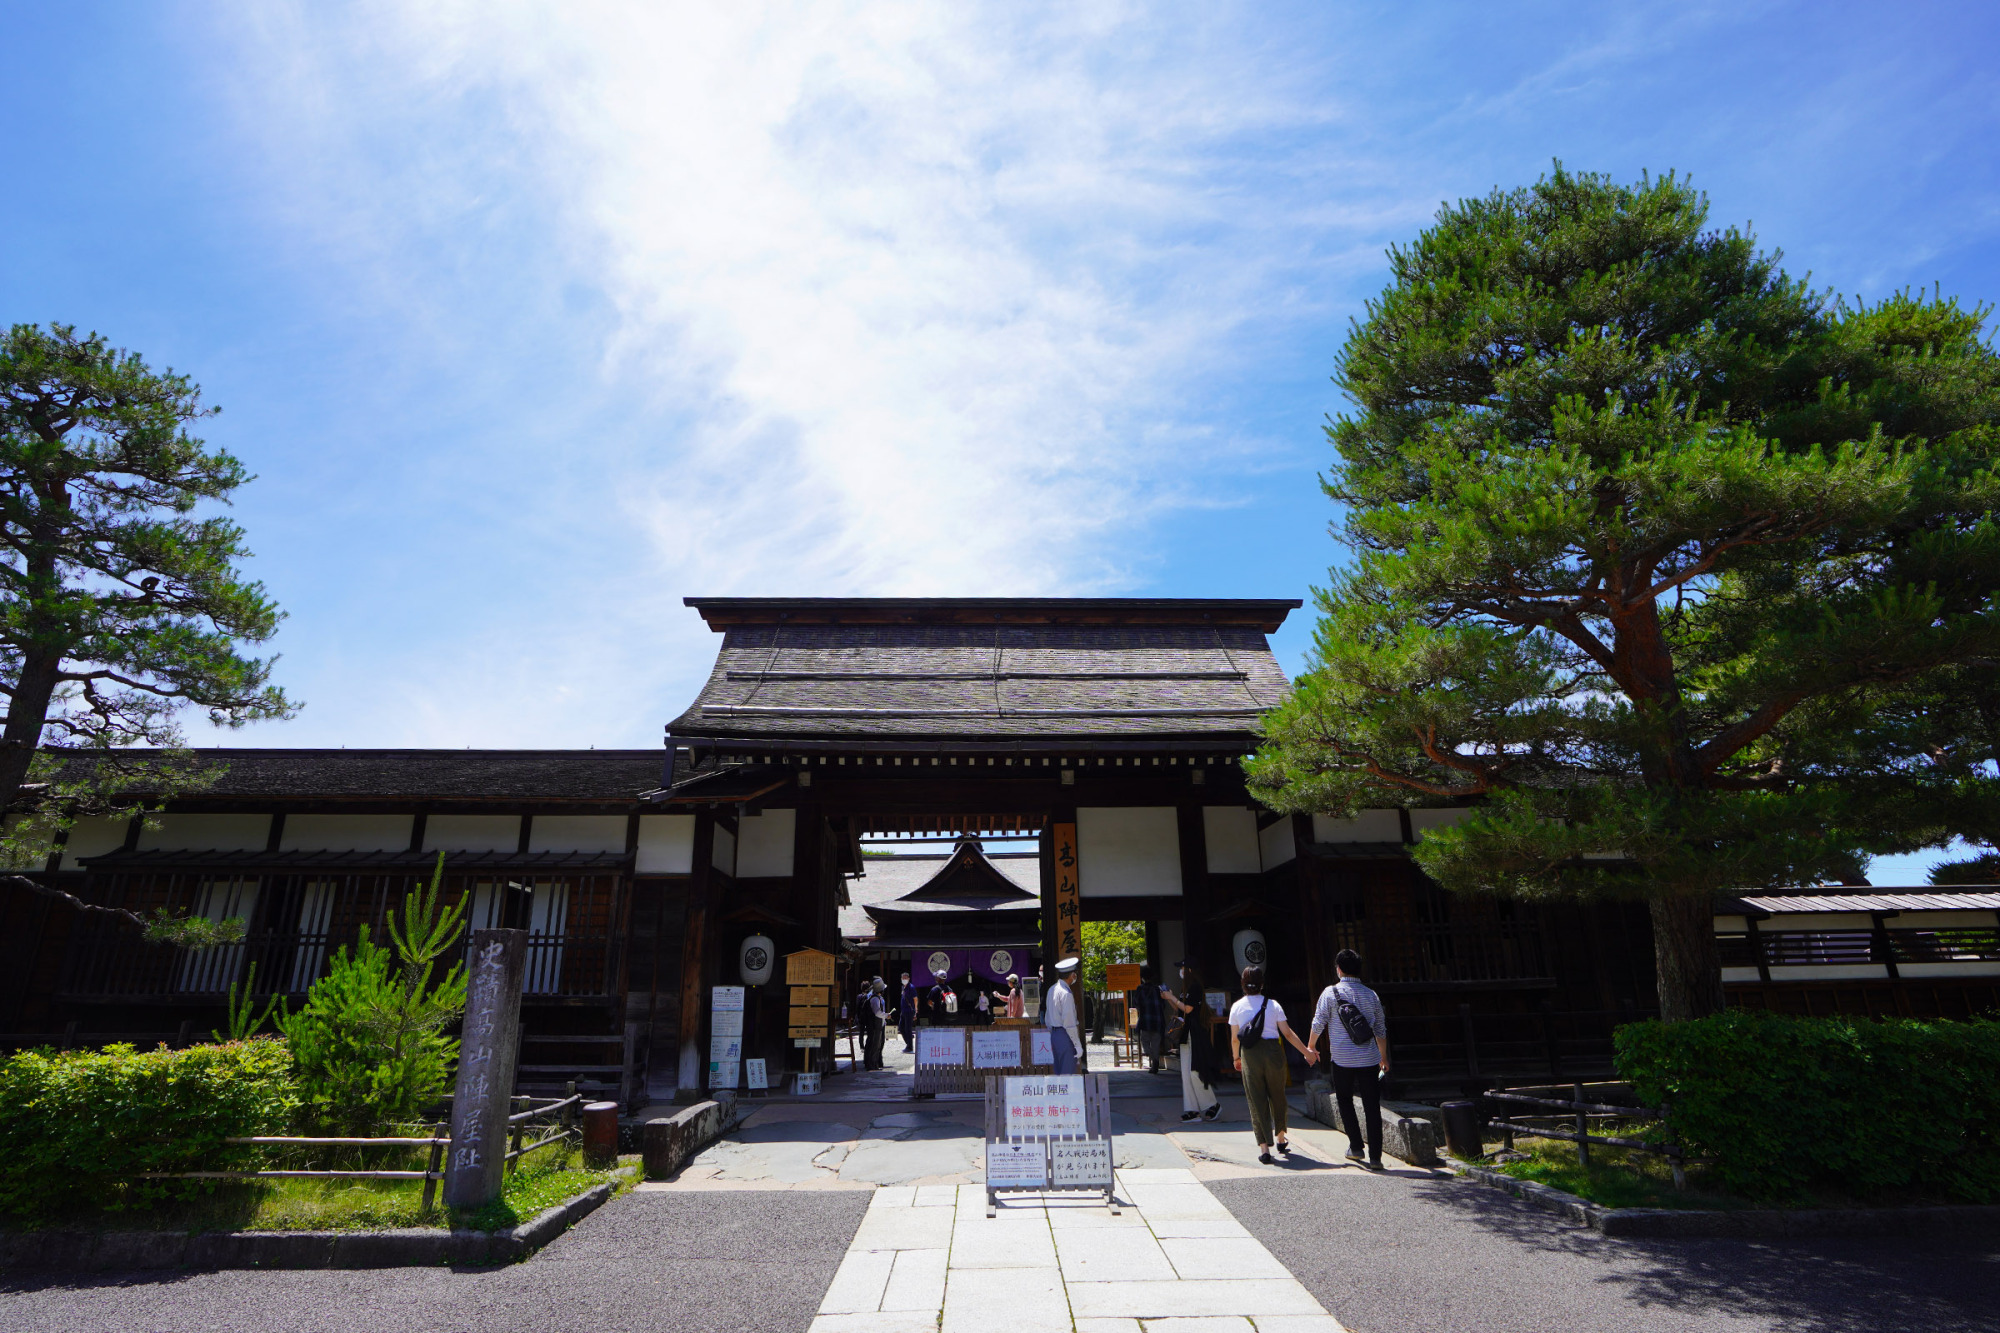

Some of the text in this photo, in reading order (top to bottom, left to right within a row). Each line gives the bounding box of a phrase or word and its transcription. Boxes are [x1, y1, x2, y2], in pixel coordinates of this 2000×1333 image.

[1058, 841, 1079, 954] 高山陣屋
[930, 1045, 951, 1057] 出口
[1039, 1041, 1054, 1053] 入
